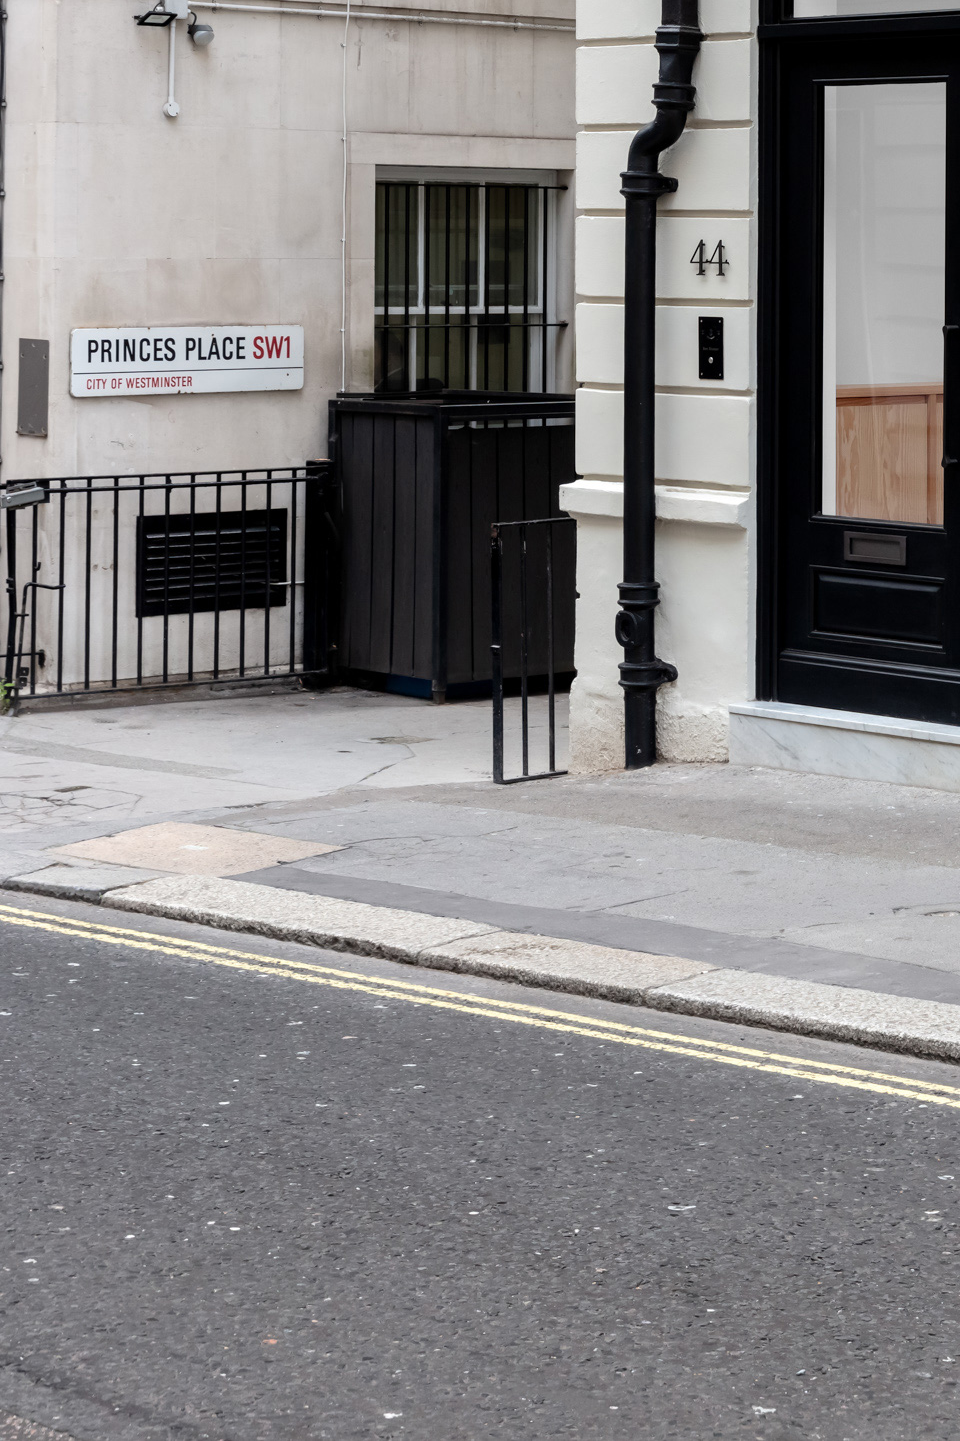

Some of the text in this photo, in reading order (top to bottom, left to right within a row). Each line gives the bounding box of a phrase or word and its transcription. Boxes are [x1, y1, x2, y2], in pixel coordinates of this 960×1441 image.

[690, 239, 729, 276] 44
[87, 335, 291, 363] PRINCES PLACE SW1
[86, 376, 193, 390] CITY OF WESTMINSTER
